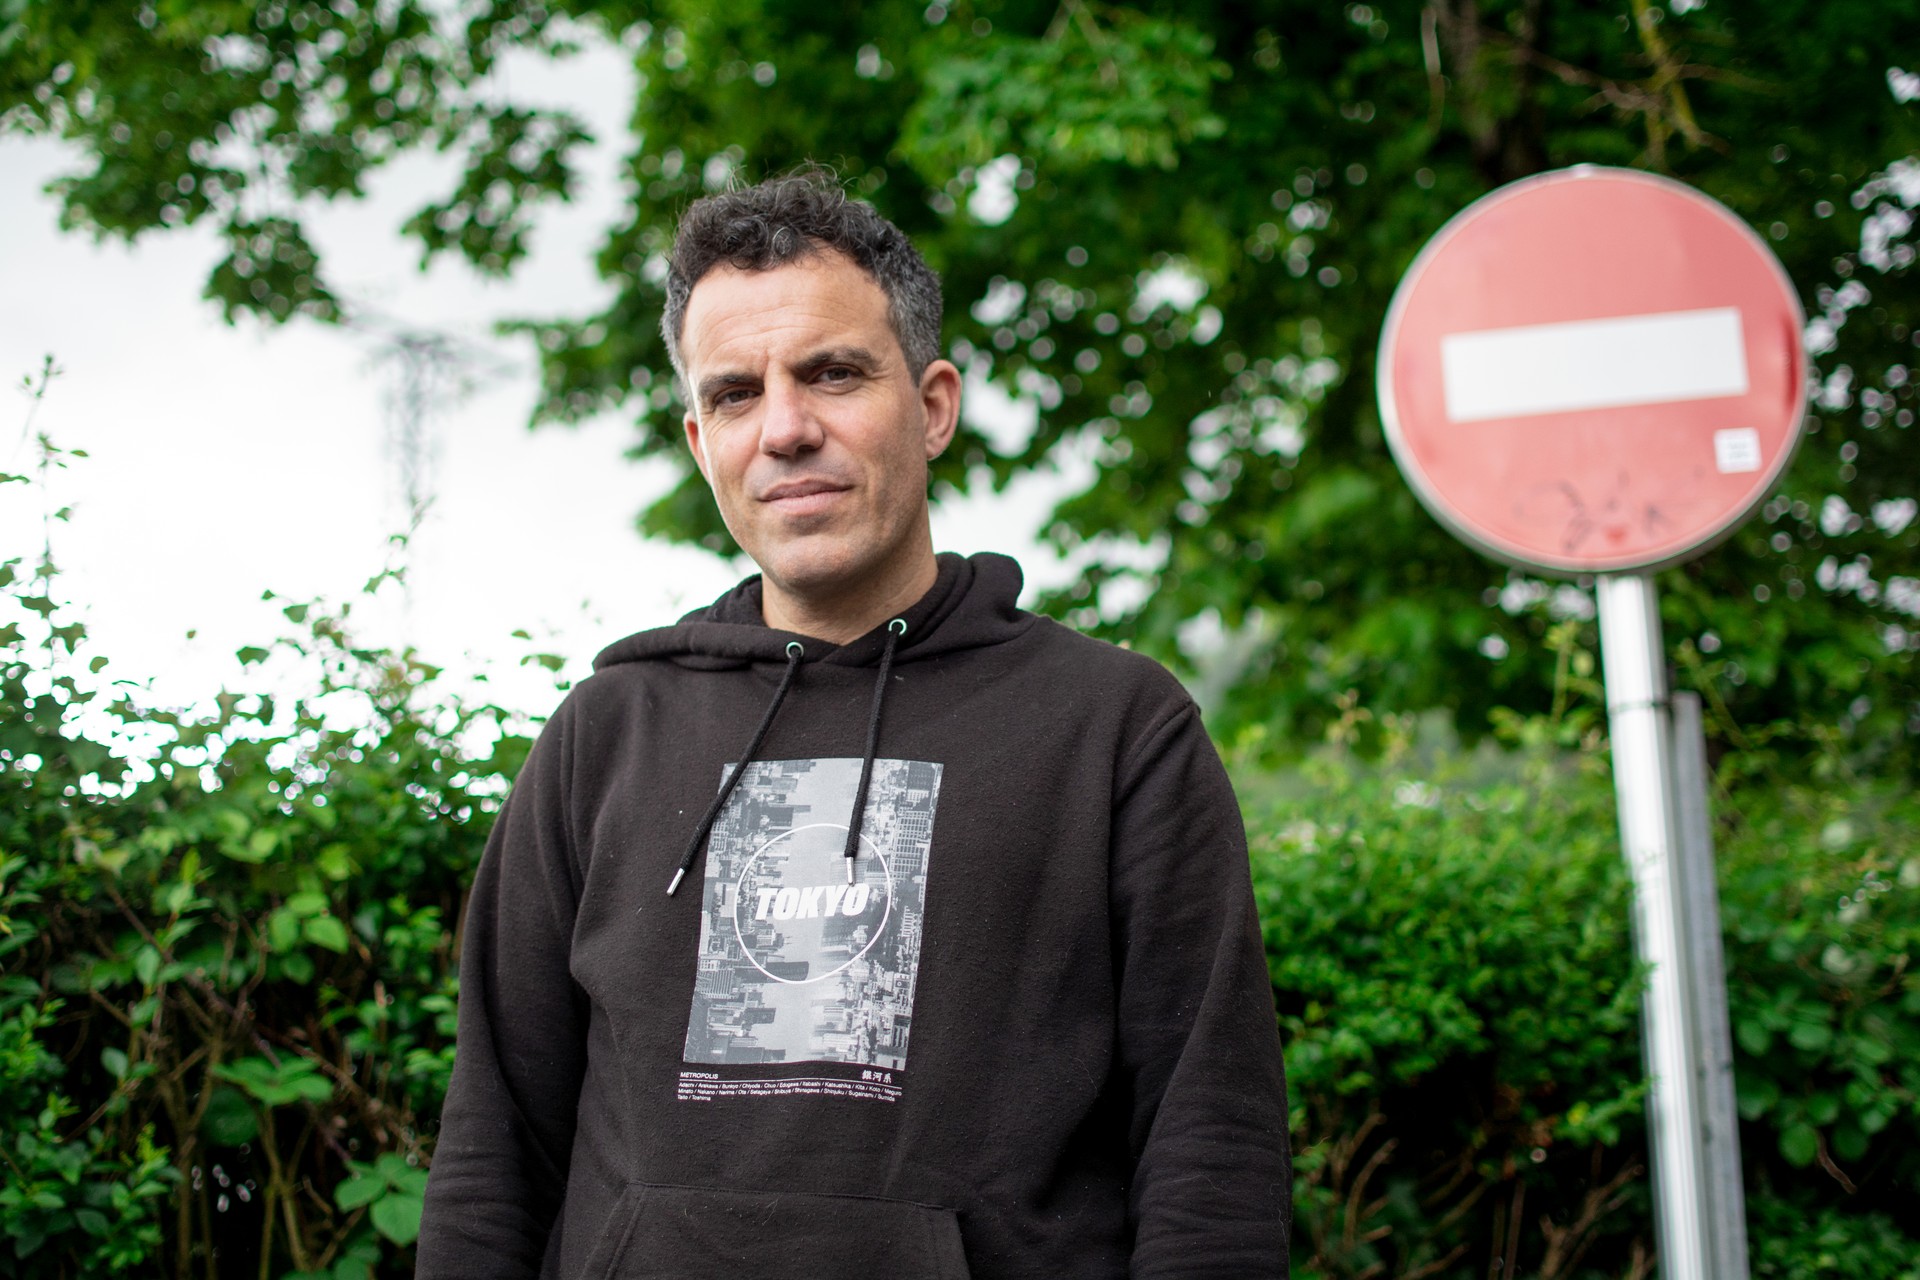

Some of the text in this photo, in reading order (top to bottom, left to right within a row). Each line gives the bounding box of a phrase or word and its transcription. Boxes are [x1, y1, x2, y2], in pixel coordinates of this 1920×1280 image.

[755, 883, 870, 920] TOKYO
[884, 1088, 902, 1096] Meguro
[878, 1094, 895, 1102] Sumida
